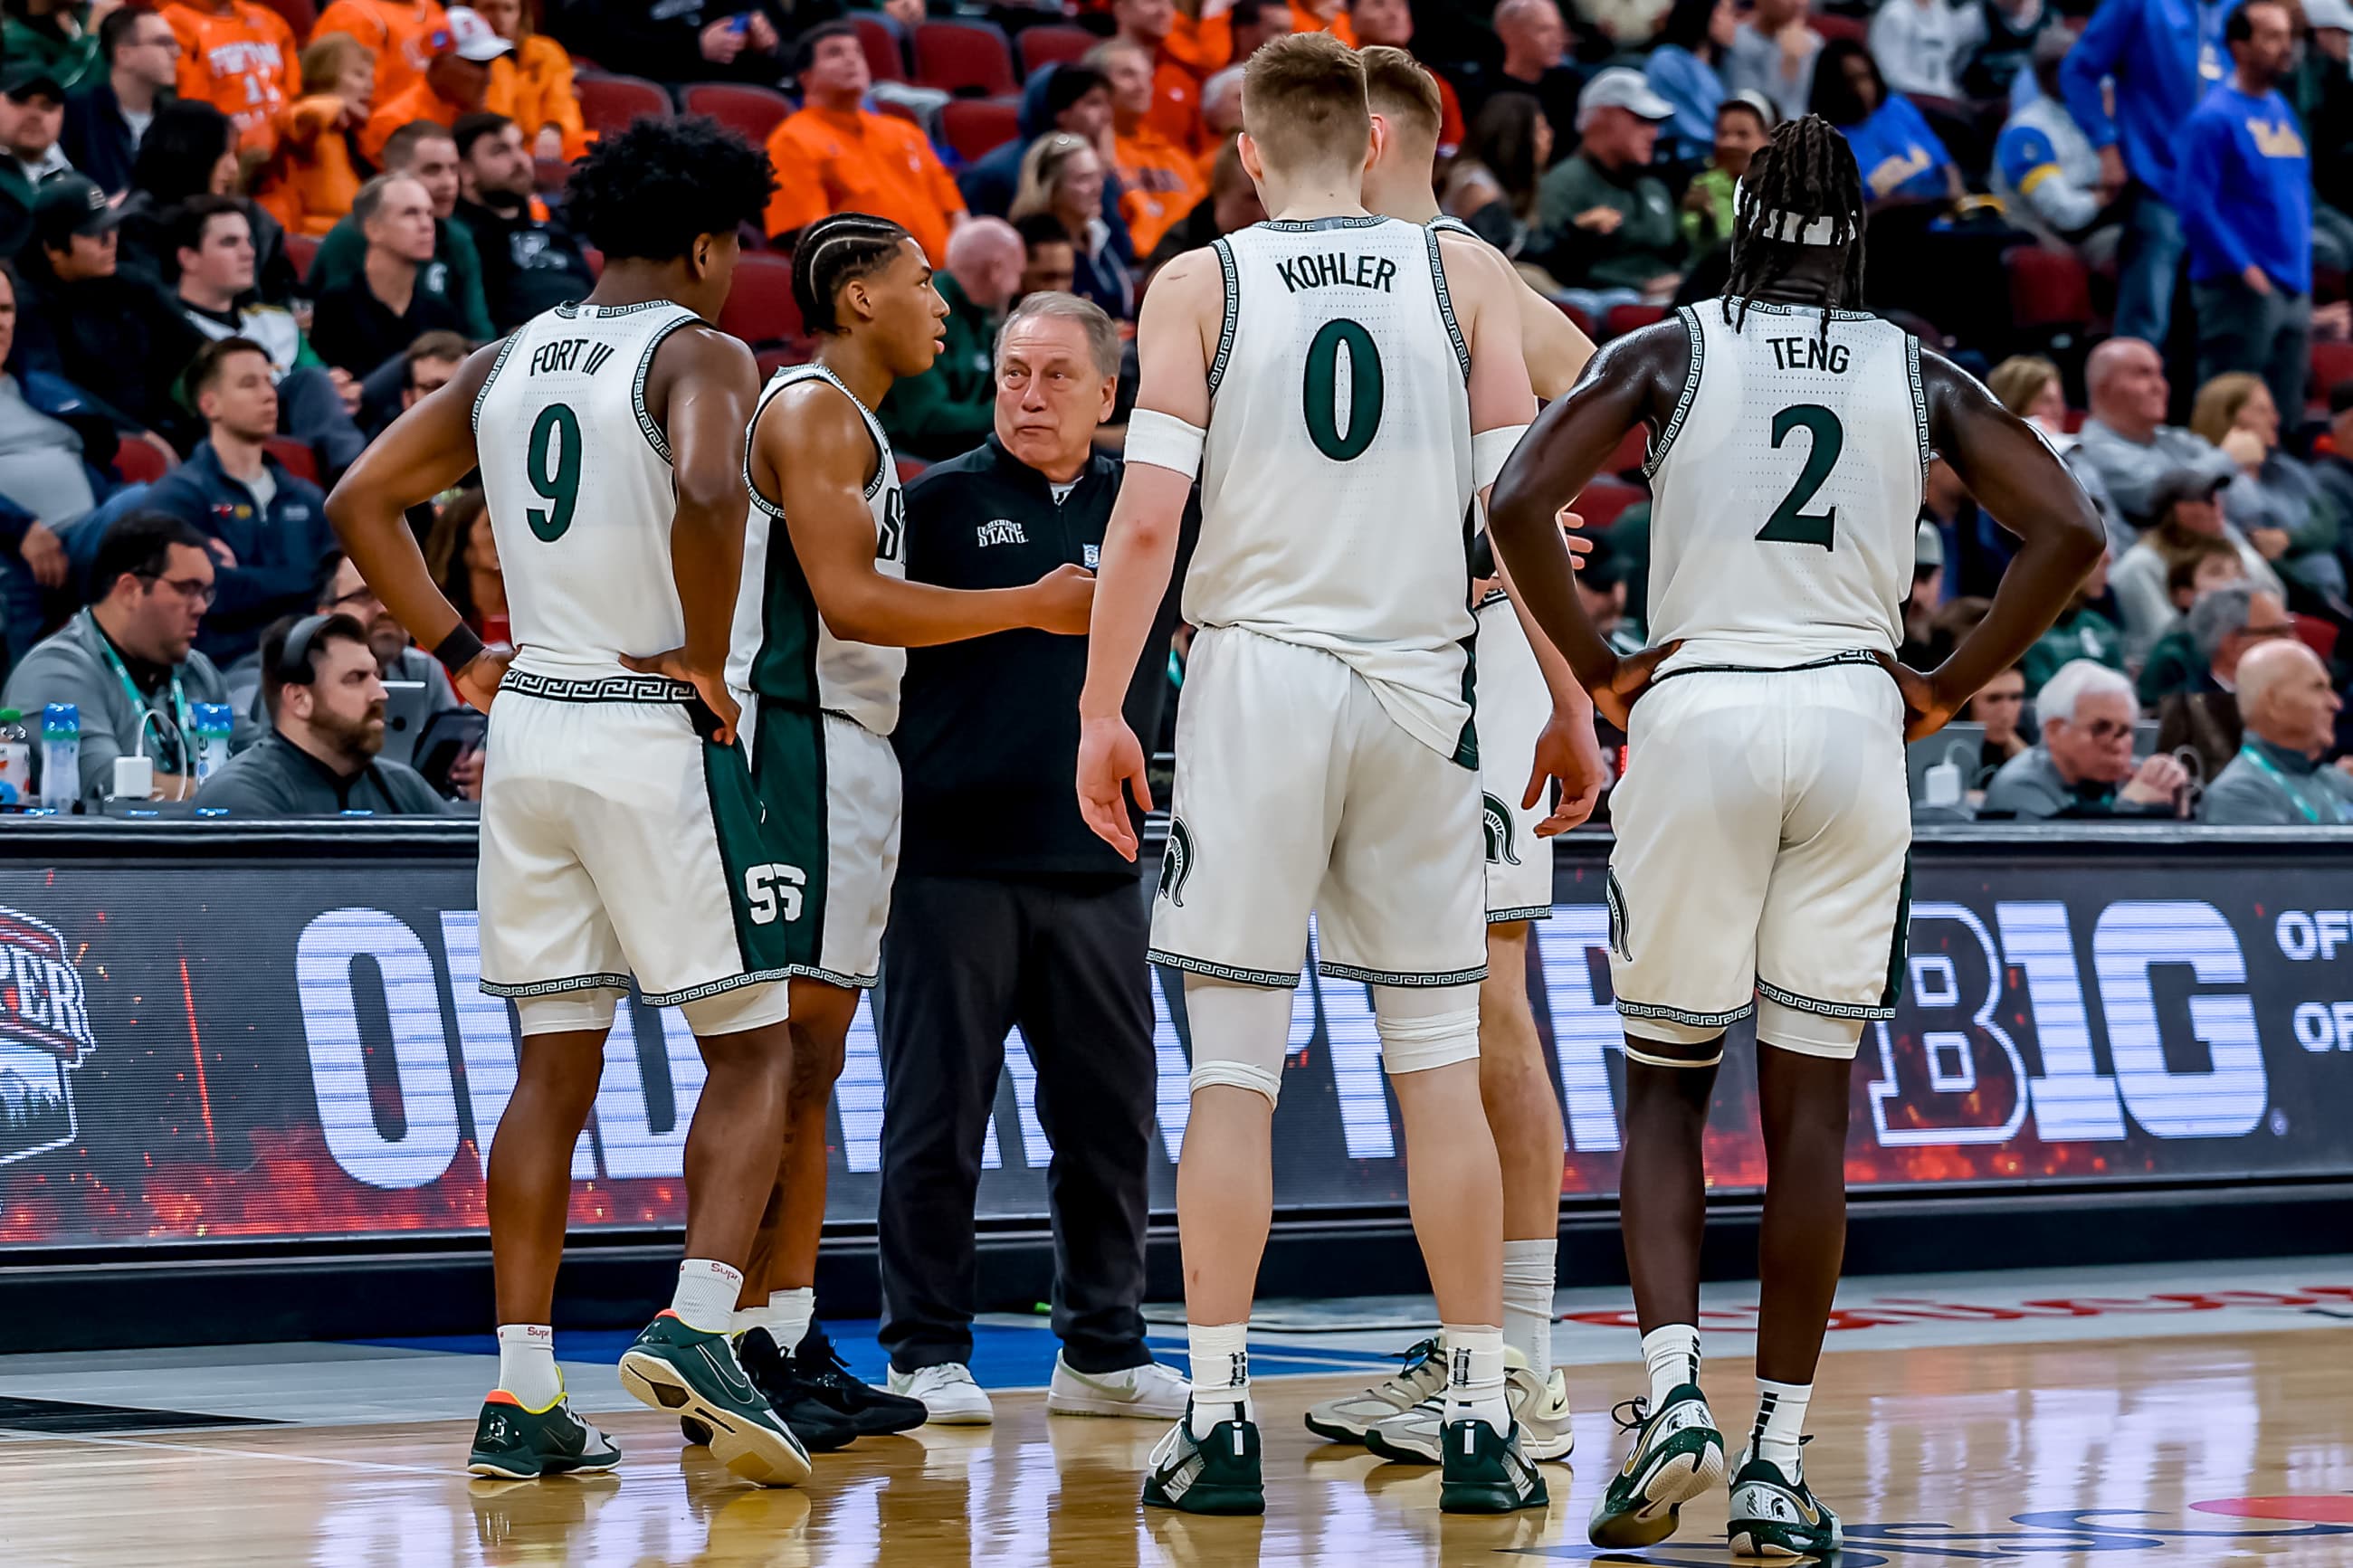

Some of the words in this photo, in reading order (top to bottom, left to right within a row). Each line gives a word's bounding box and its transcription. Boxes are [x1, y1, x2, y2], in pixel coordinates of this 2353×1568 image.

[1276, 252, 1396, 293] KOHLER
[529, 338, 589, 376] FORT
[582, 341, 615, 375] III
[1766, 337, 1851, 374] TENG
[1302, 318, 1385, 461] 0
[526, 403, 582, 542] 9
[1755, 404, 1843, 552] 2
[977, 522, 1024, 547] STATE
[2275, 910, 2353, 961] OF
